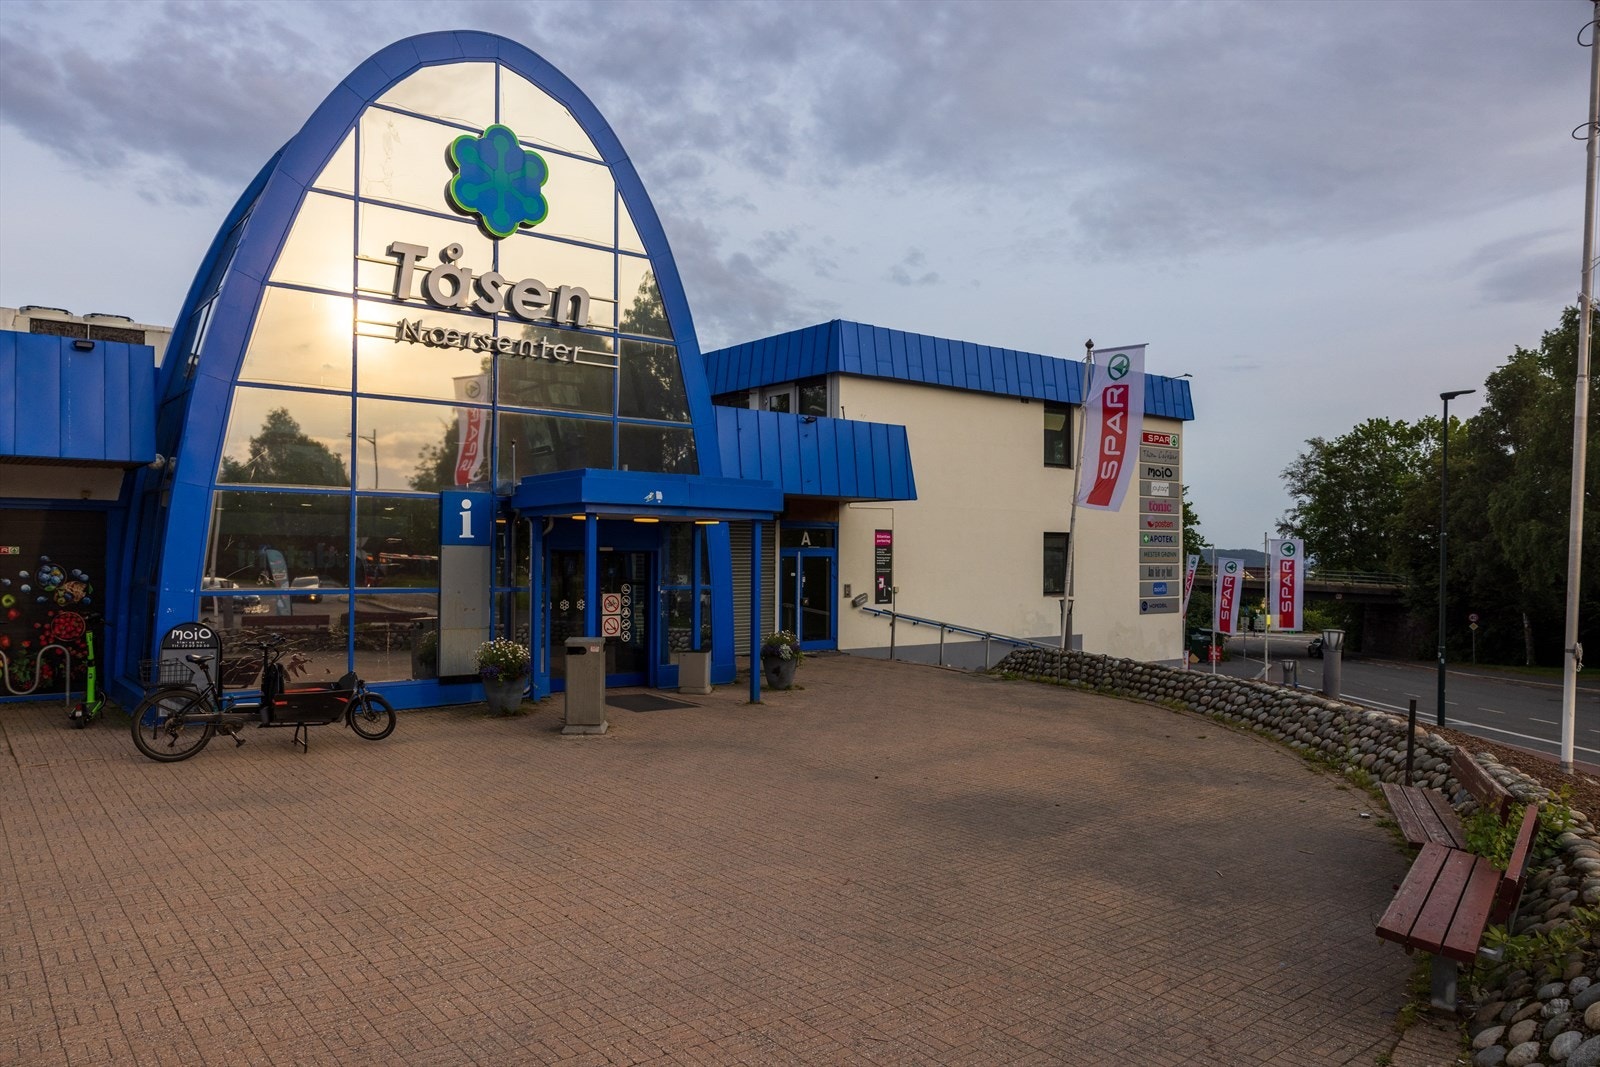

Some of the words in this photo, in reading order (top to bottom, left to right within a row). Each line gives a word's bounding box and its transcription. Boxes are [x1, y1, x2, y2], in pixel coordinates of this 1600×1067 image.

[388, 241, 590, 326] Tåsen
[397, 317, 584, 365] Nærsenter
[1101, 386, 1125, 480] SPAR
[1148, 434, 1170, 444] SPAR
[801, 532, 812, 546] A
[1149, 535, 1173, 543] APOTEK
[1220, 576, 1234, 620] SPAR
[1280, 560, 1293, 613] SPAR
